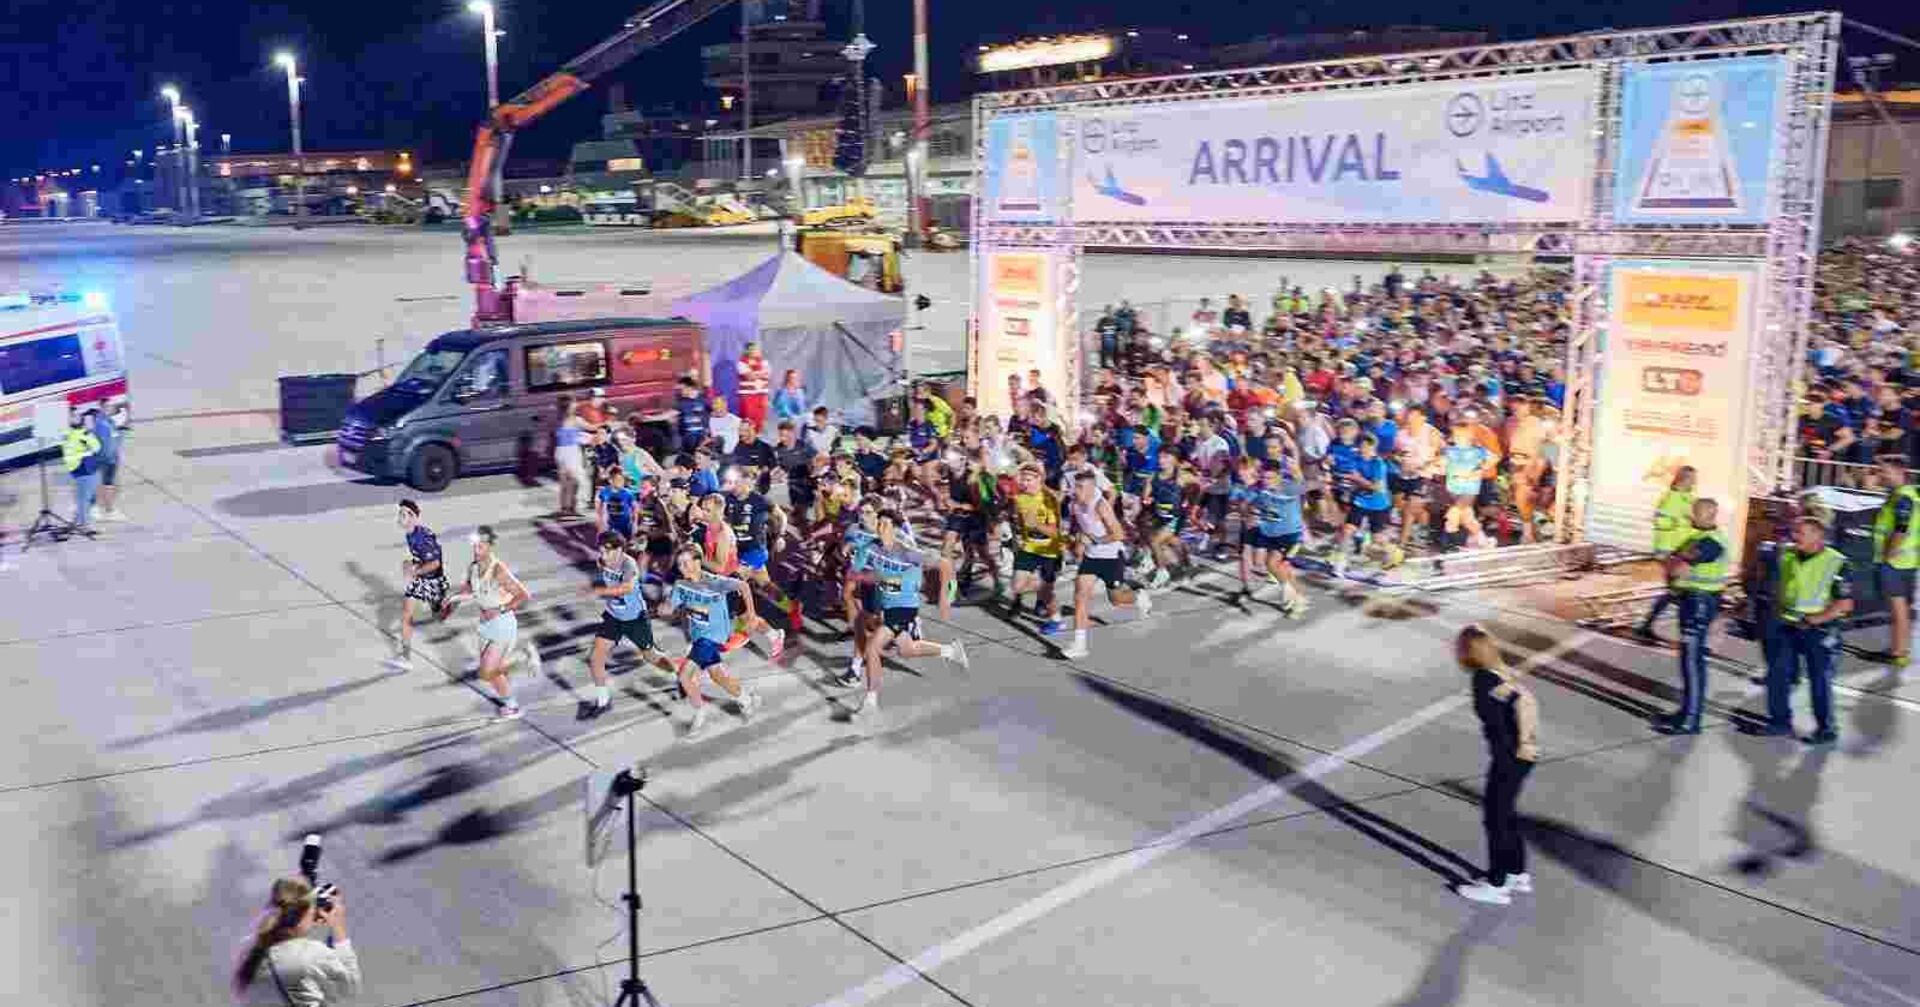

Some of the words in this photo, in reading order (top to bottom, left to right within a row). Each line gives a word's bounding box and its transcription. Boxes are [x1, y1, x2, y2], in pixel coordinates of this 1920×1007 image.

[1491, 89, 1533, 111] Linz
[1491, 115, 1566, 138] Airport
[1189, 131, 1401, 185] ARRIVAL
